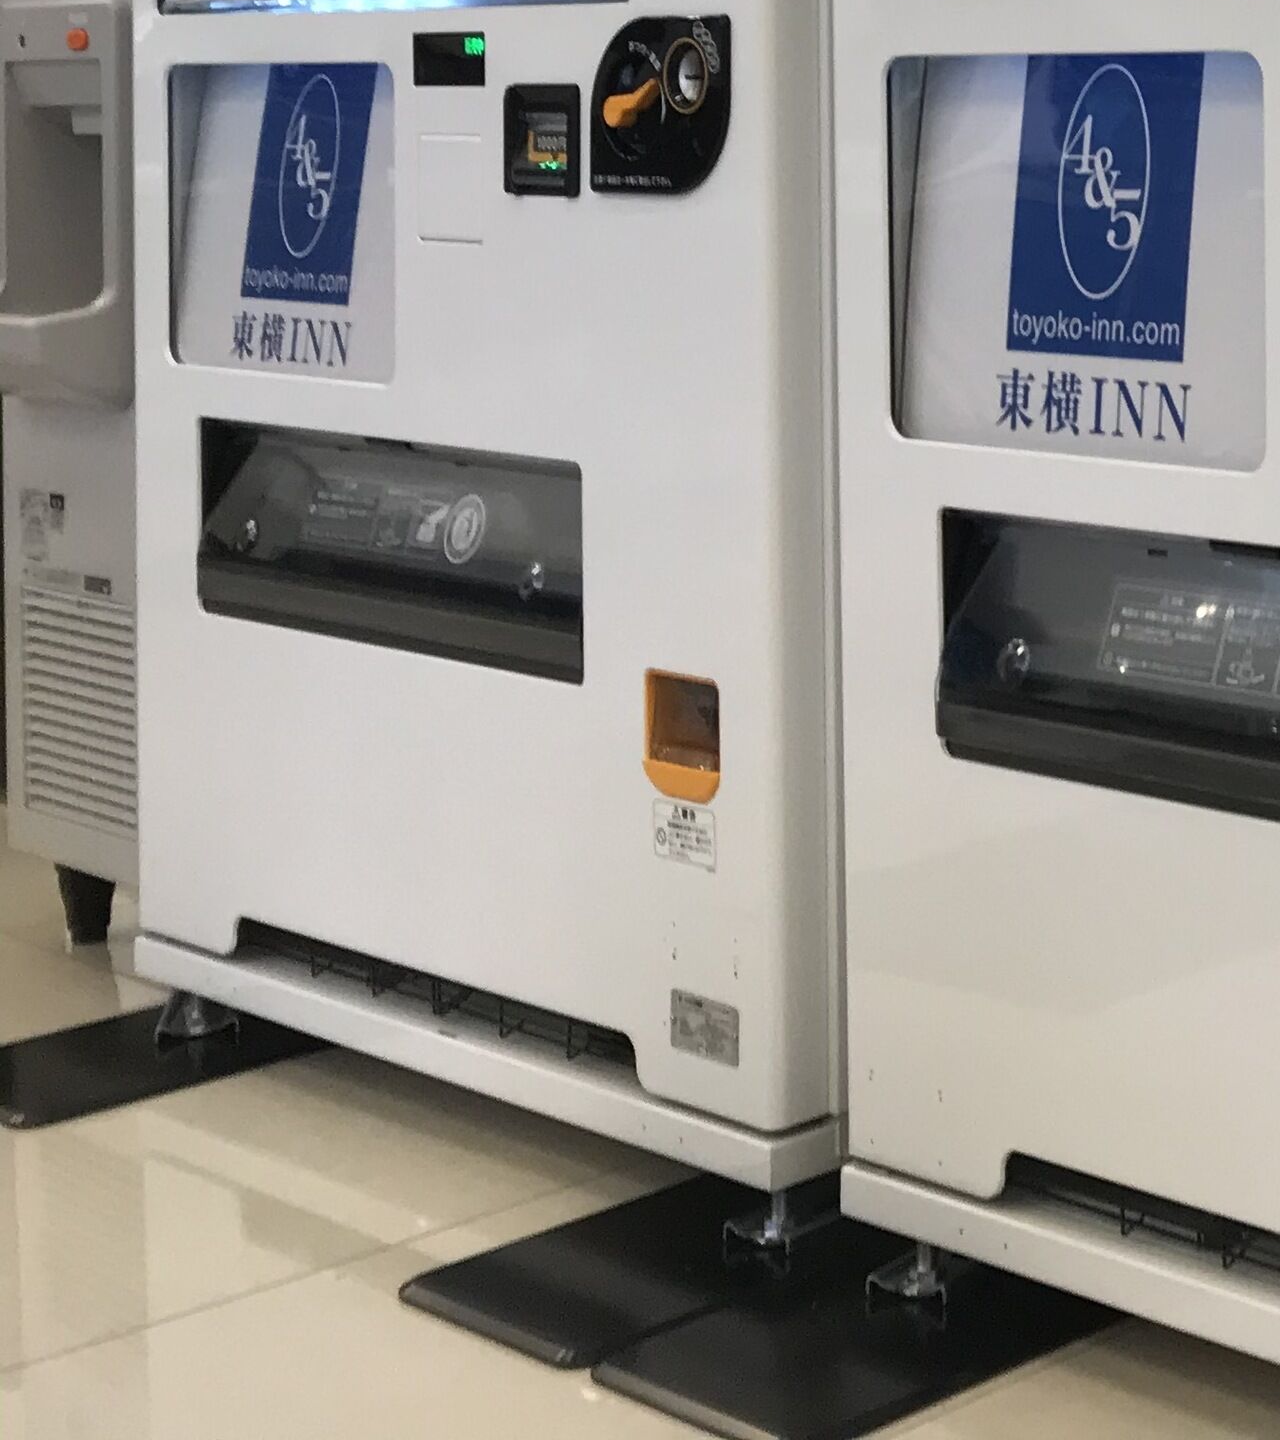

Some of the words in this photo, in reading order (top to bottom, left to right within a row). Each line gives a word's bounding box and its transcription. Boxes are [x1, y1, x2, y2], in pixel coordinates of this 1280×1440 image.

[243, 266, 349, 296] toyoko-inn.com
[229, 310, 353, 369] 東横INN
[1012, 308, 1181, 347] toyoko-inn.com
[995, 368, 1193, 443] 東横INN
